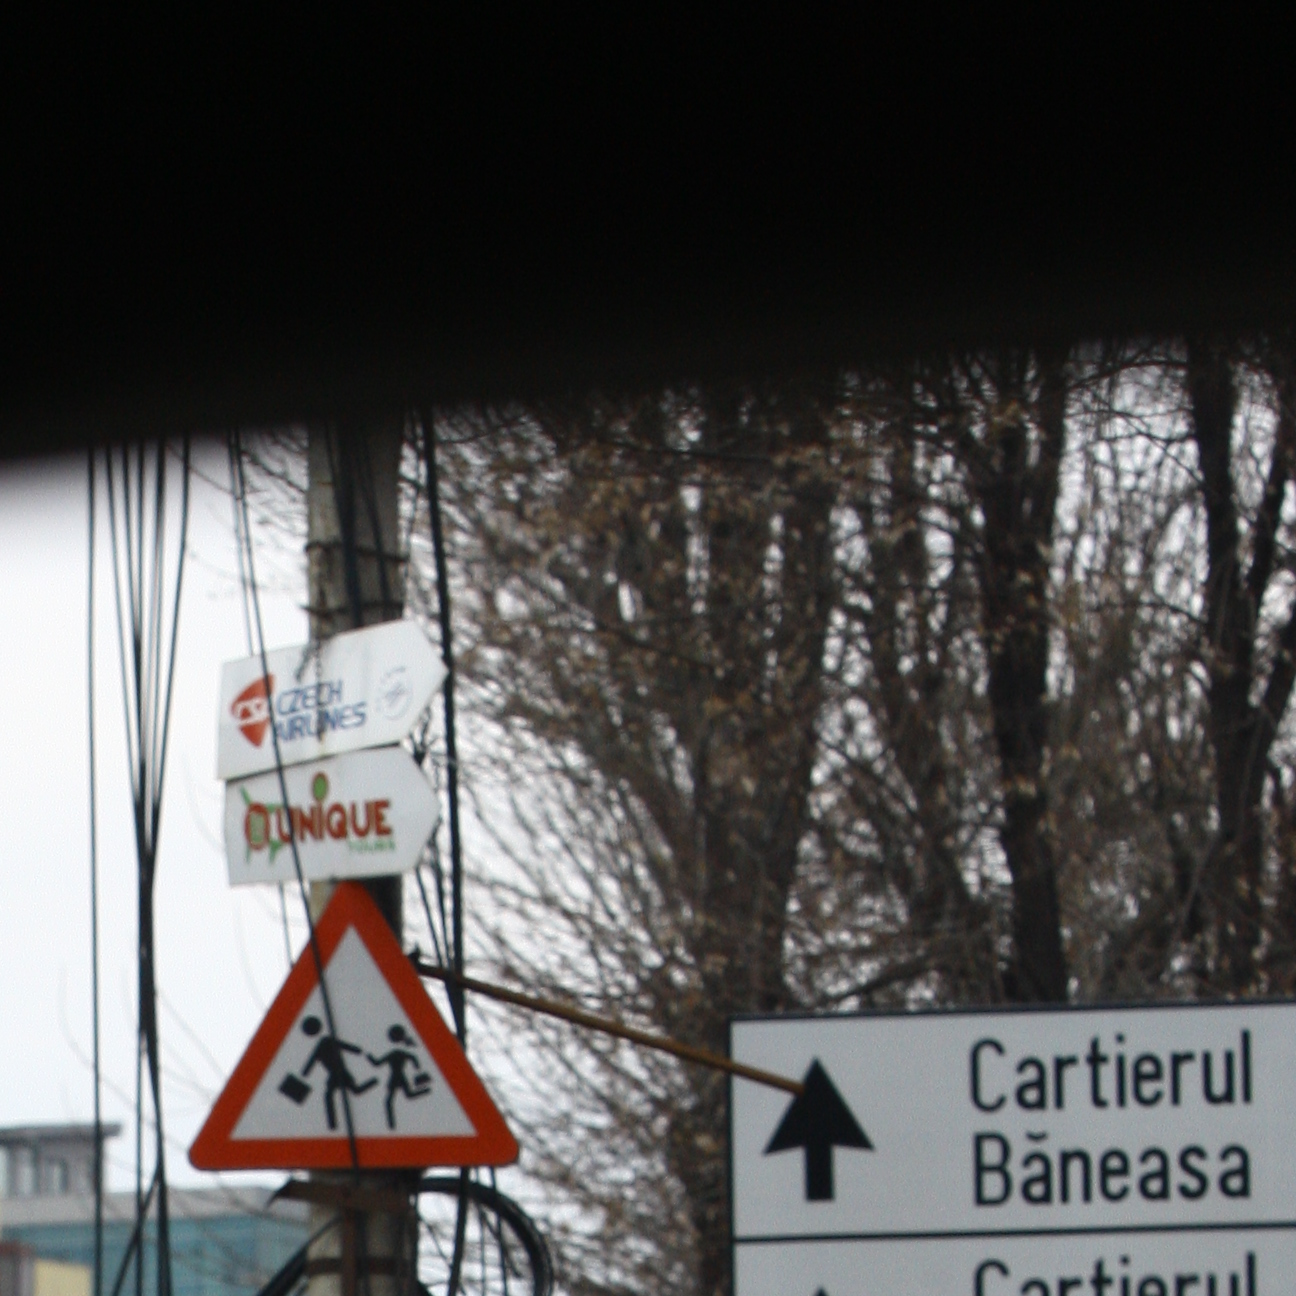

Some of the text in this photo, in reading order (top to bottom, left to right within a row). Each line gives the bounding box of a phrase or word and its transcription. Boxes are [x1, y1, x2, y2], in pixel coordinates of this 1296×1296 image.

[276, 679, 343, 717] CZECH
[968, 1028, 1254, 1113] Cartierul
[971, 1130, 1252, 1208] Băneasa
